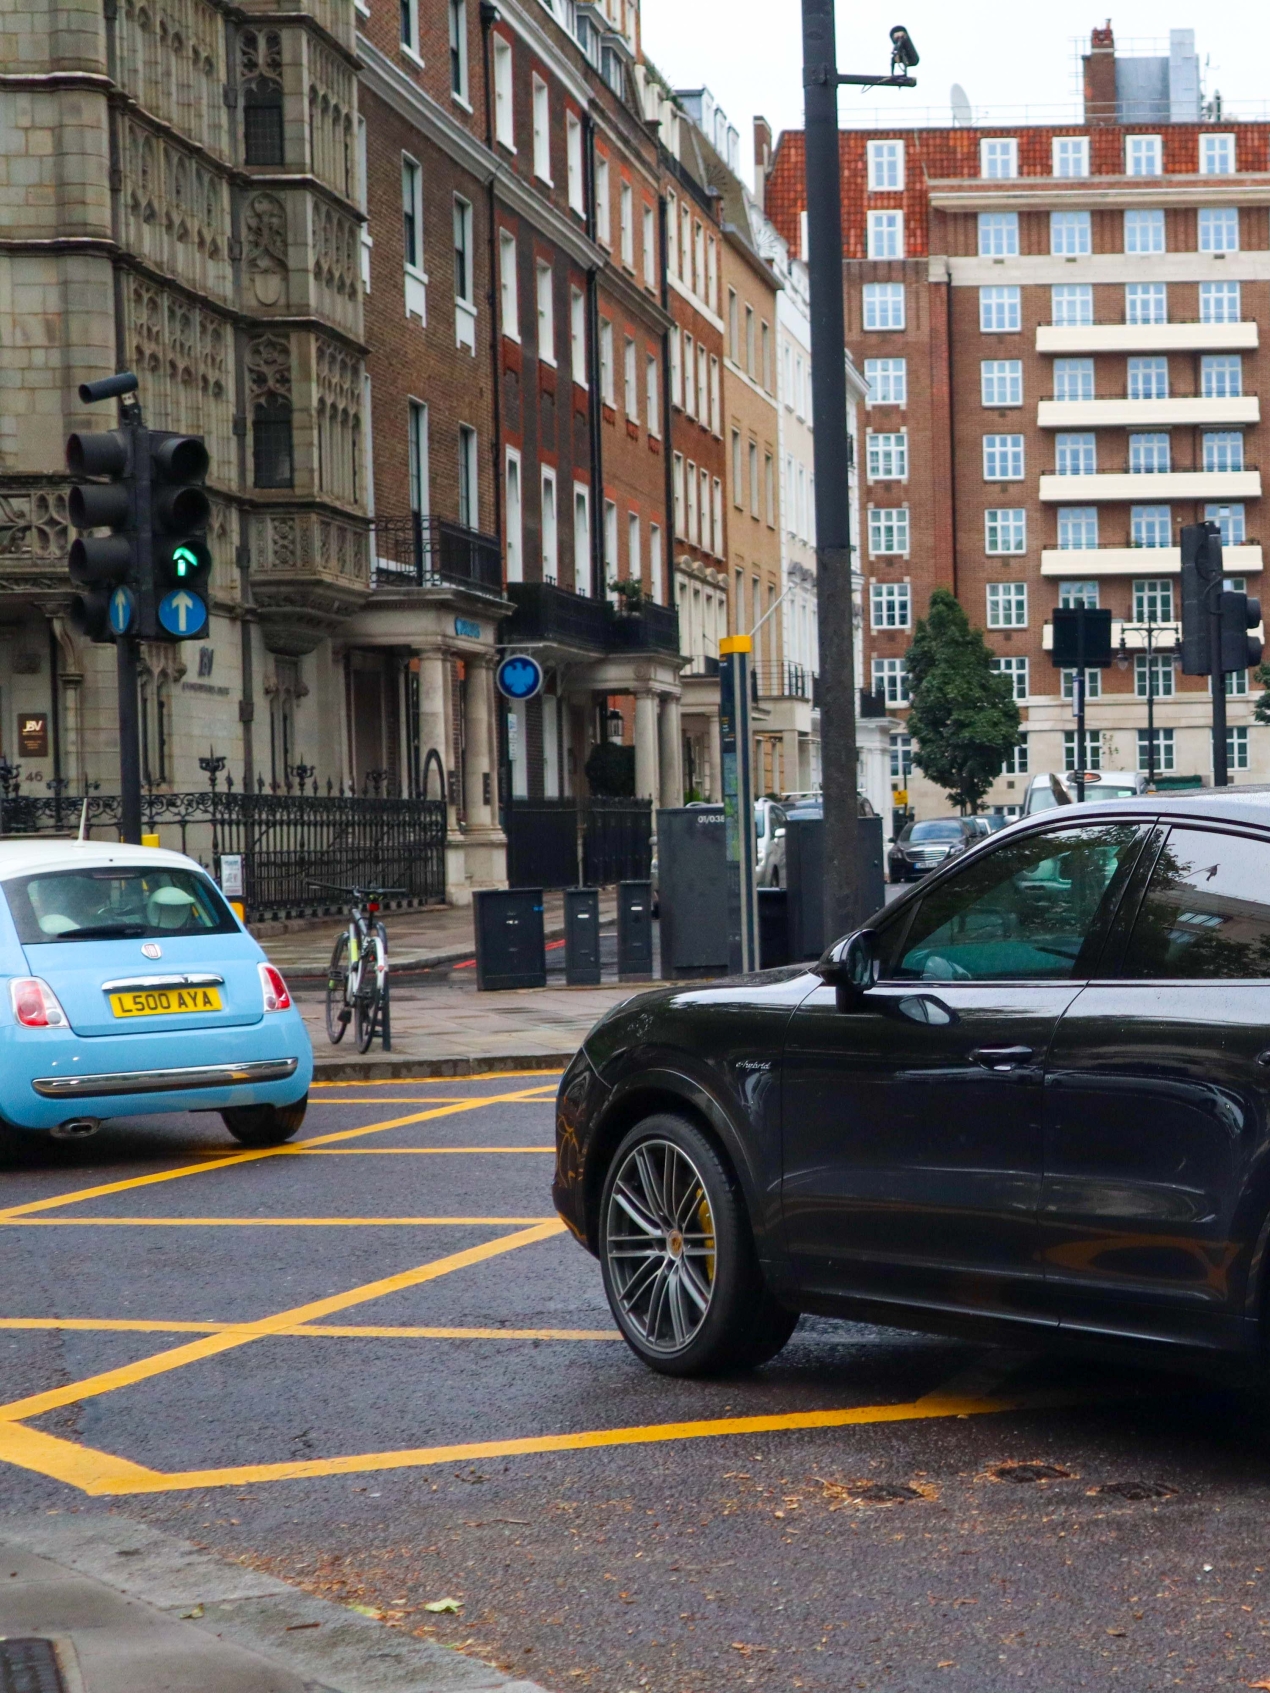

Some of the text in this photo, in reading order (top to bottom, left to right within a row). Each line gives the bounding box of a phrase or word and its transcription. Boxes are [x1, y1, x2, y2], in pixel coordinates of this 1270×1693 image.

[22, 720, 43, 732] JBV
[25, 771, 43, 782] 46
[118, 990, 213, 1013] L500 AYA
